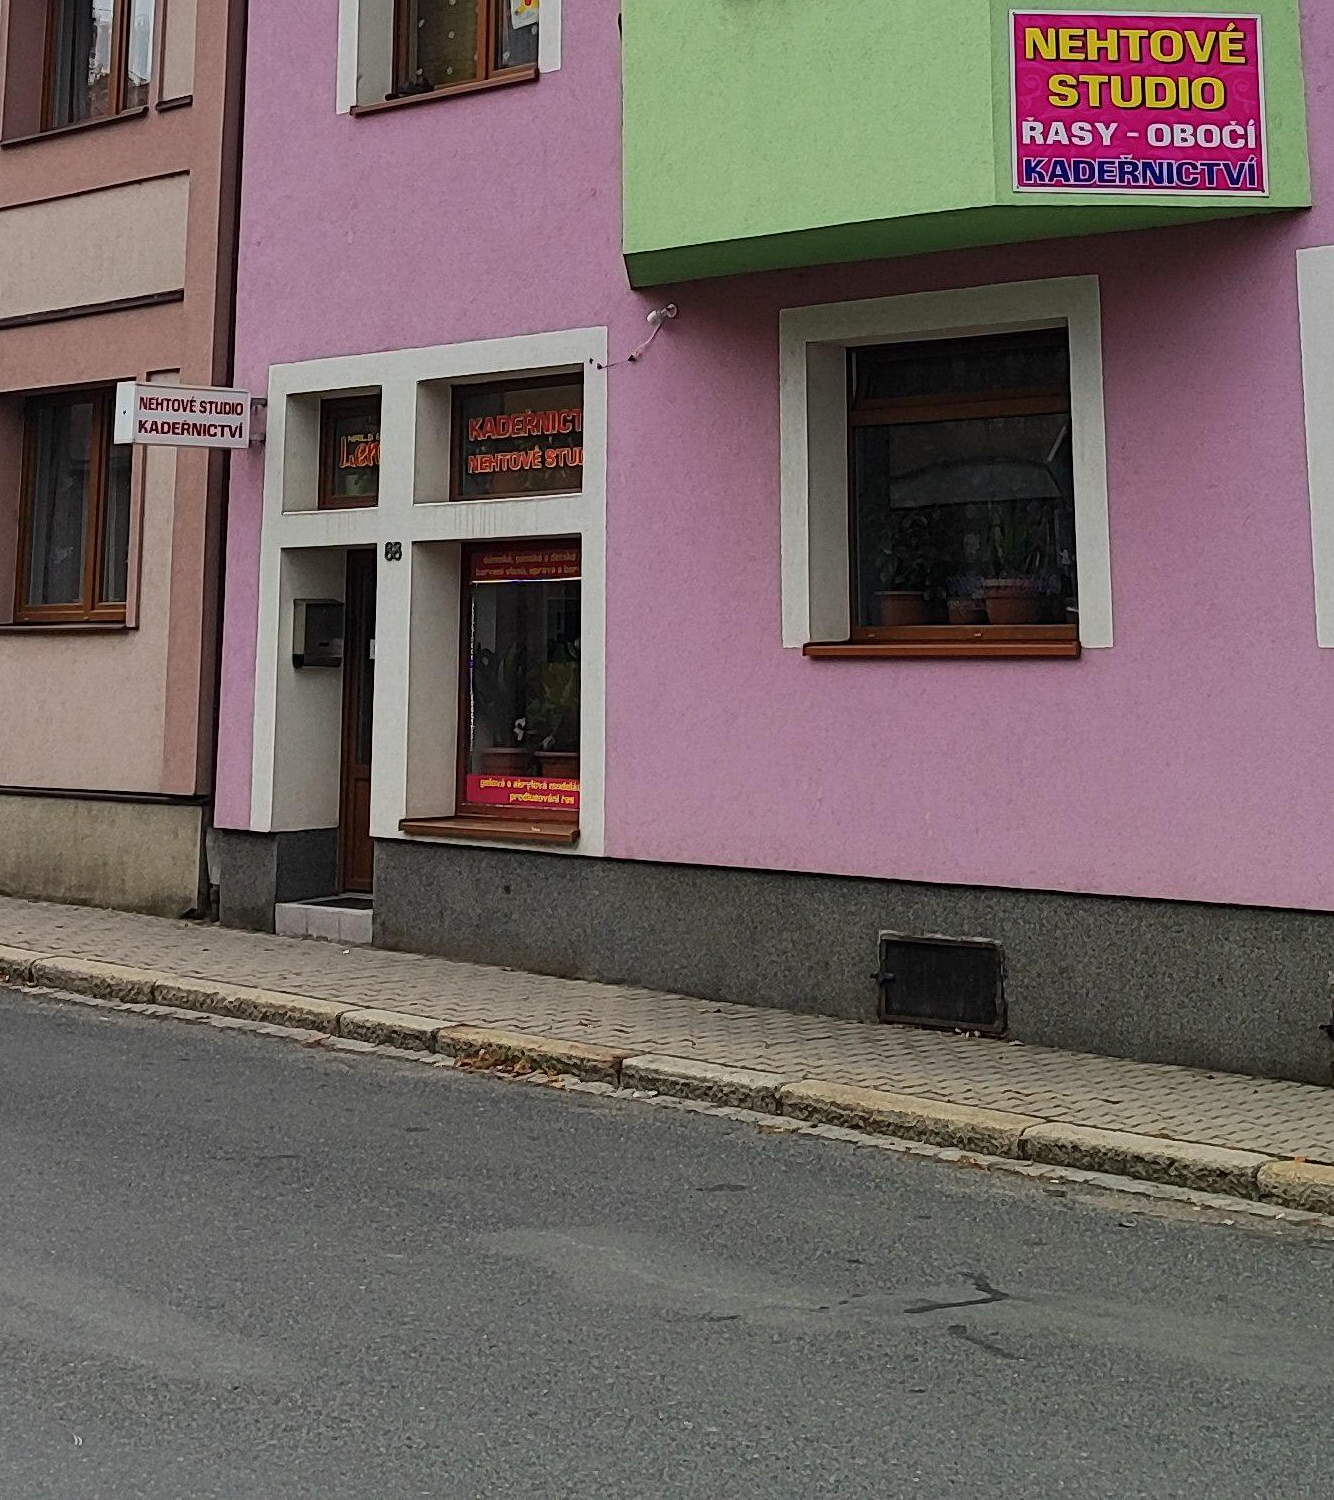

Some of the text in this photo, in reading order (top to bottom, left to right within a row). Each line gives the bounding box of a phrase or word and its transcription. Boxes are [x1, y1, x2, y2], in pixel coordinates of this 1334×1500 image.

[1025, 22, 1246, 64] NEHTOVÉ
[1048, 74, 1226, 109] STUDIO
[1021, 116, 1119, 146] ŘASY
[1147, 118, 1257, 149] OBOČÍ
[1022, 154, 1258, 188] KADEŘNICTVÍ
[139, 396, 244, 416] NEHTOVÉ STUDIO
[137, 419, 243, 439] KADEŘNICTVÍ
[468, 444, 542, 474] NEHTOVÉ
